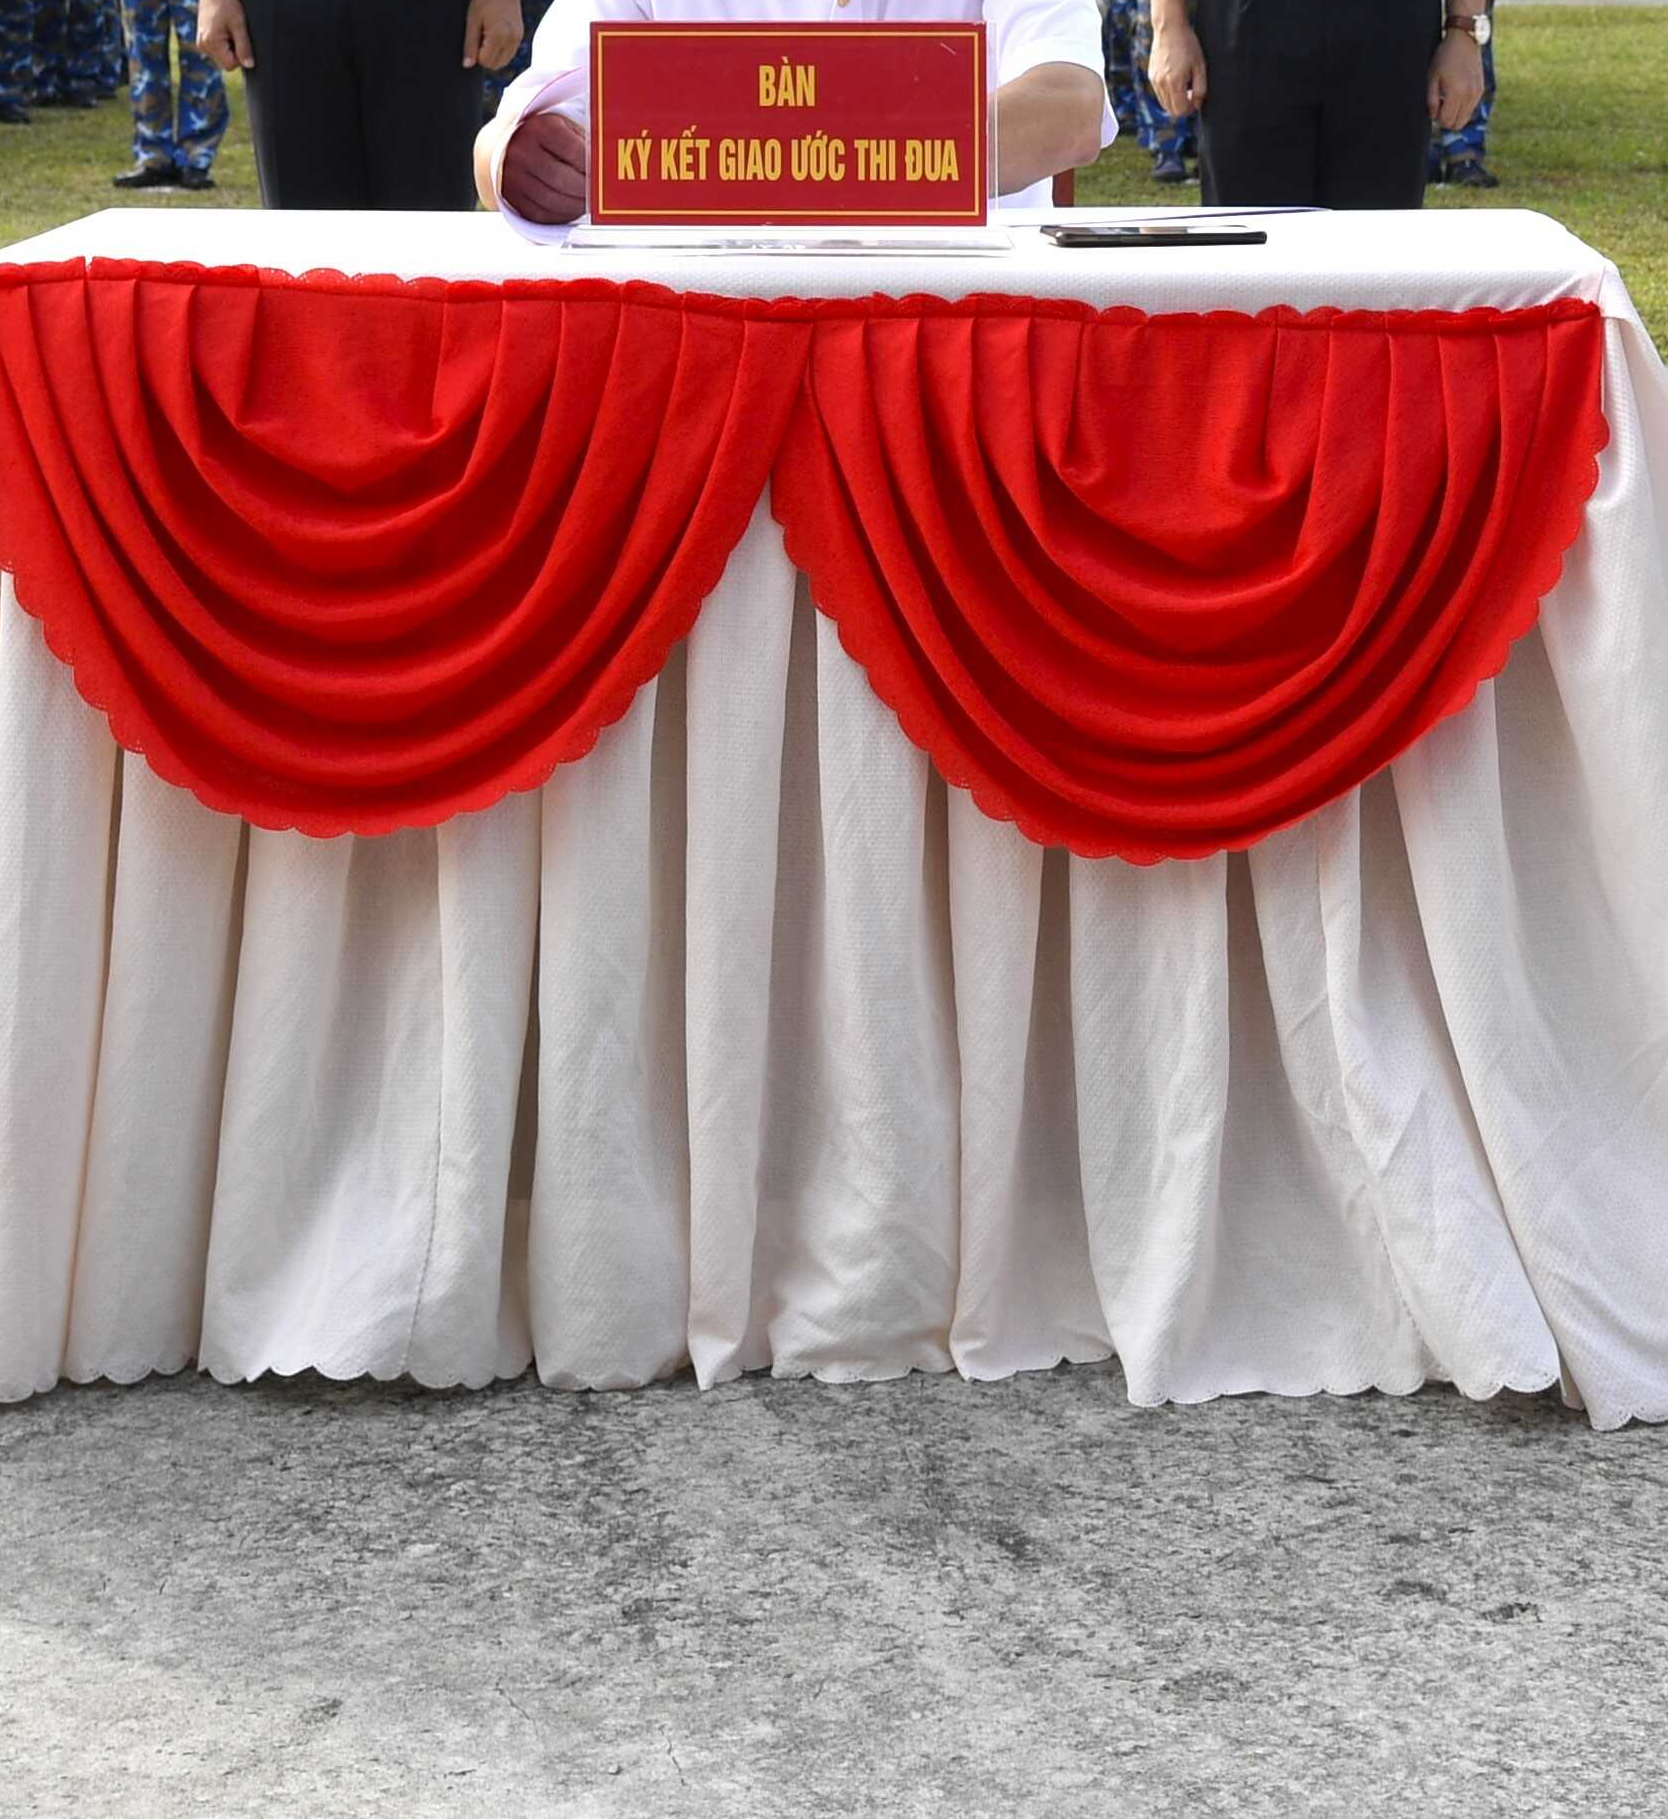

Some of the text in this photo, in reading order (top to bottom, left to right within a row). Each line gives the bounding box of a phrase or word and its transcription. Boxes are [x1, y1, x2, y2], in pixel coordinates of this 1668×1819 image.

[758, 56, 816, 107] BÀN
[617, 124, 960, 182] KÝ KẾT GIAO ƯỚC THI ĐUA
